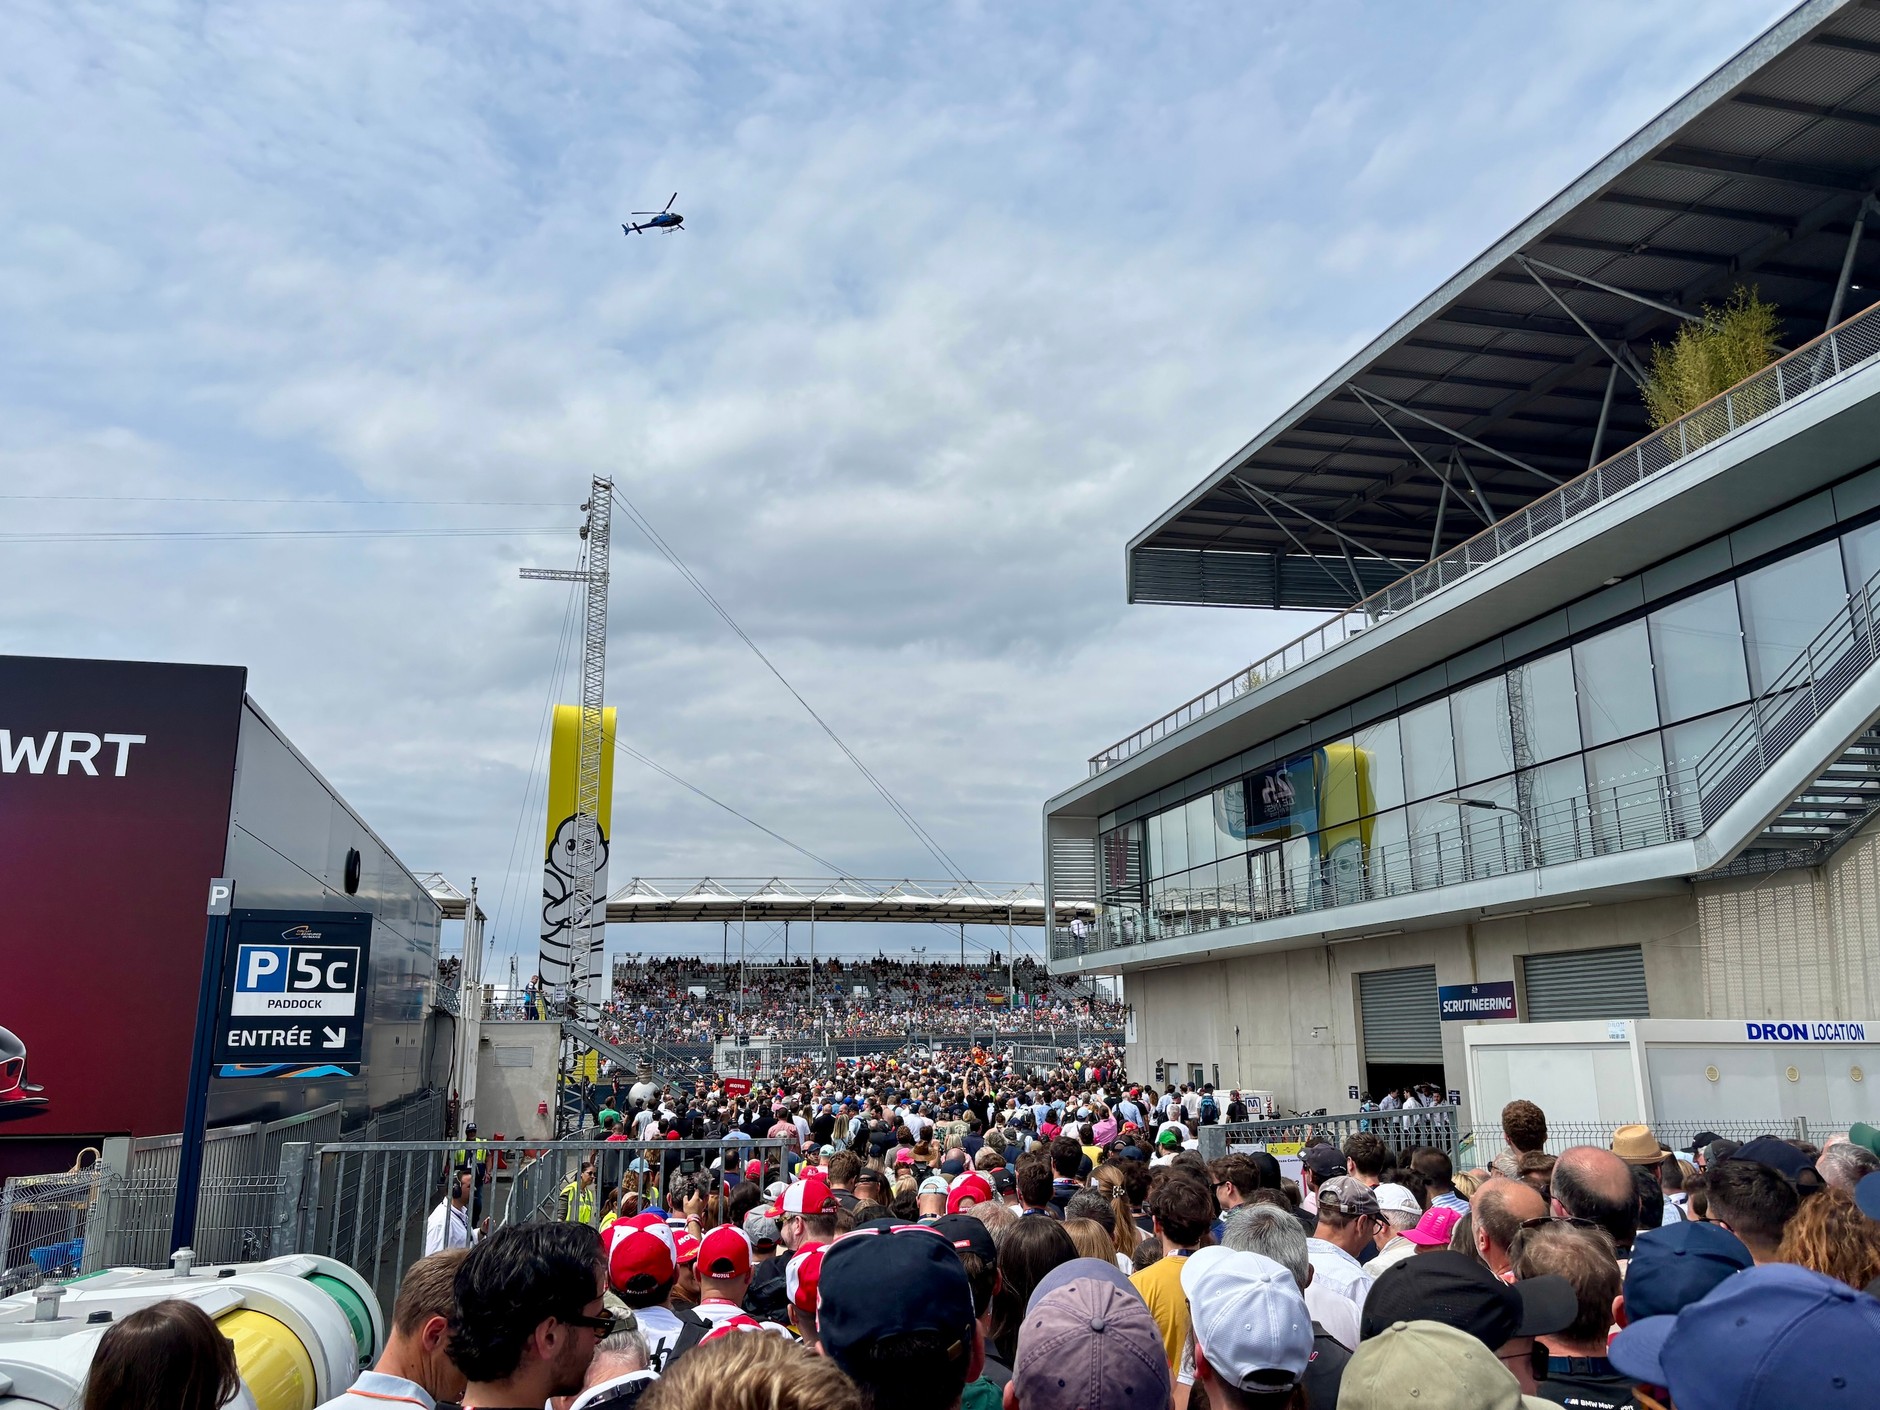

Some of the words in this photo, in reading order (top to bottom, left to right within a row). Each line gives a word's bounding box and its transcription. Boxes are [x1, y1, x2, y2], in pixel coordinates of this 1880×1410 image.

[0, 728, 147, 777] WRT
[210, 886, 229, 906] P
[247, 951, 279, 988] P
[294, 952, 348, 989] 5c
[267, 999, 322, 1009] PADDOCK
[1442, 996, 1512, 1013] SCRUTINEERING
[227, 1025, 312, 1047] ENTRÉE
[1746, 1023, 1809, 1041] DRON
[1811, 1023, 1865, 1041] LOCATION
